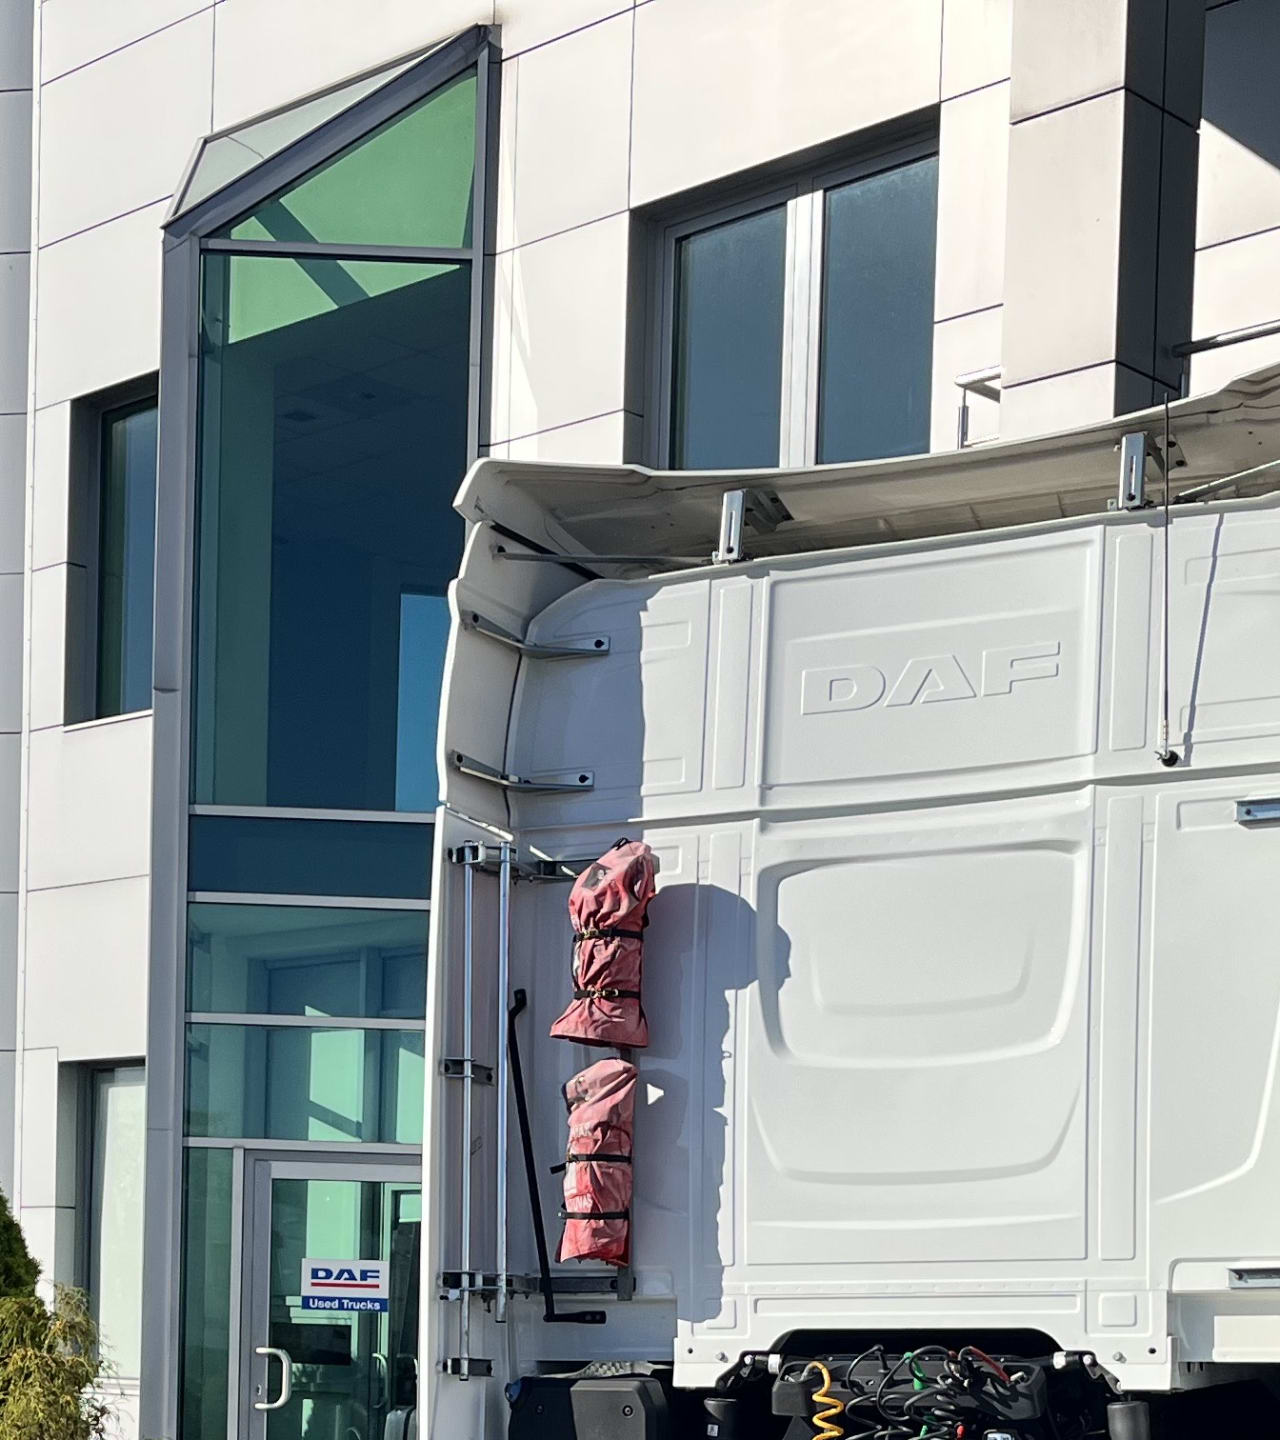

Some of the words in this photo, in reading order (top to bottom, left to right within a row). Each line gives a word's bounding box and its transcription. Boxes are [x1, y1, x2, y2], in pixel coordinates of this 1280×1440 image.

[800, 640, 1061, 716] DAF
[311, 1267, 380, 1281] DAF
[309, 1298, 339, 1309] Used
[341, 1299, 380, 1310] Trucks
